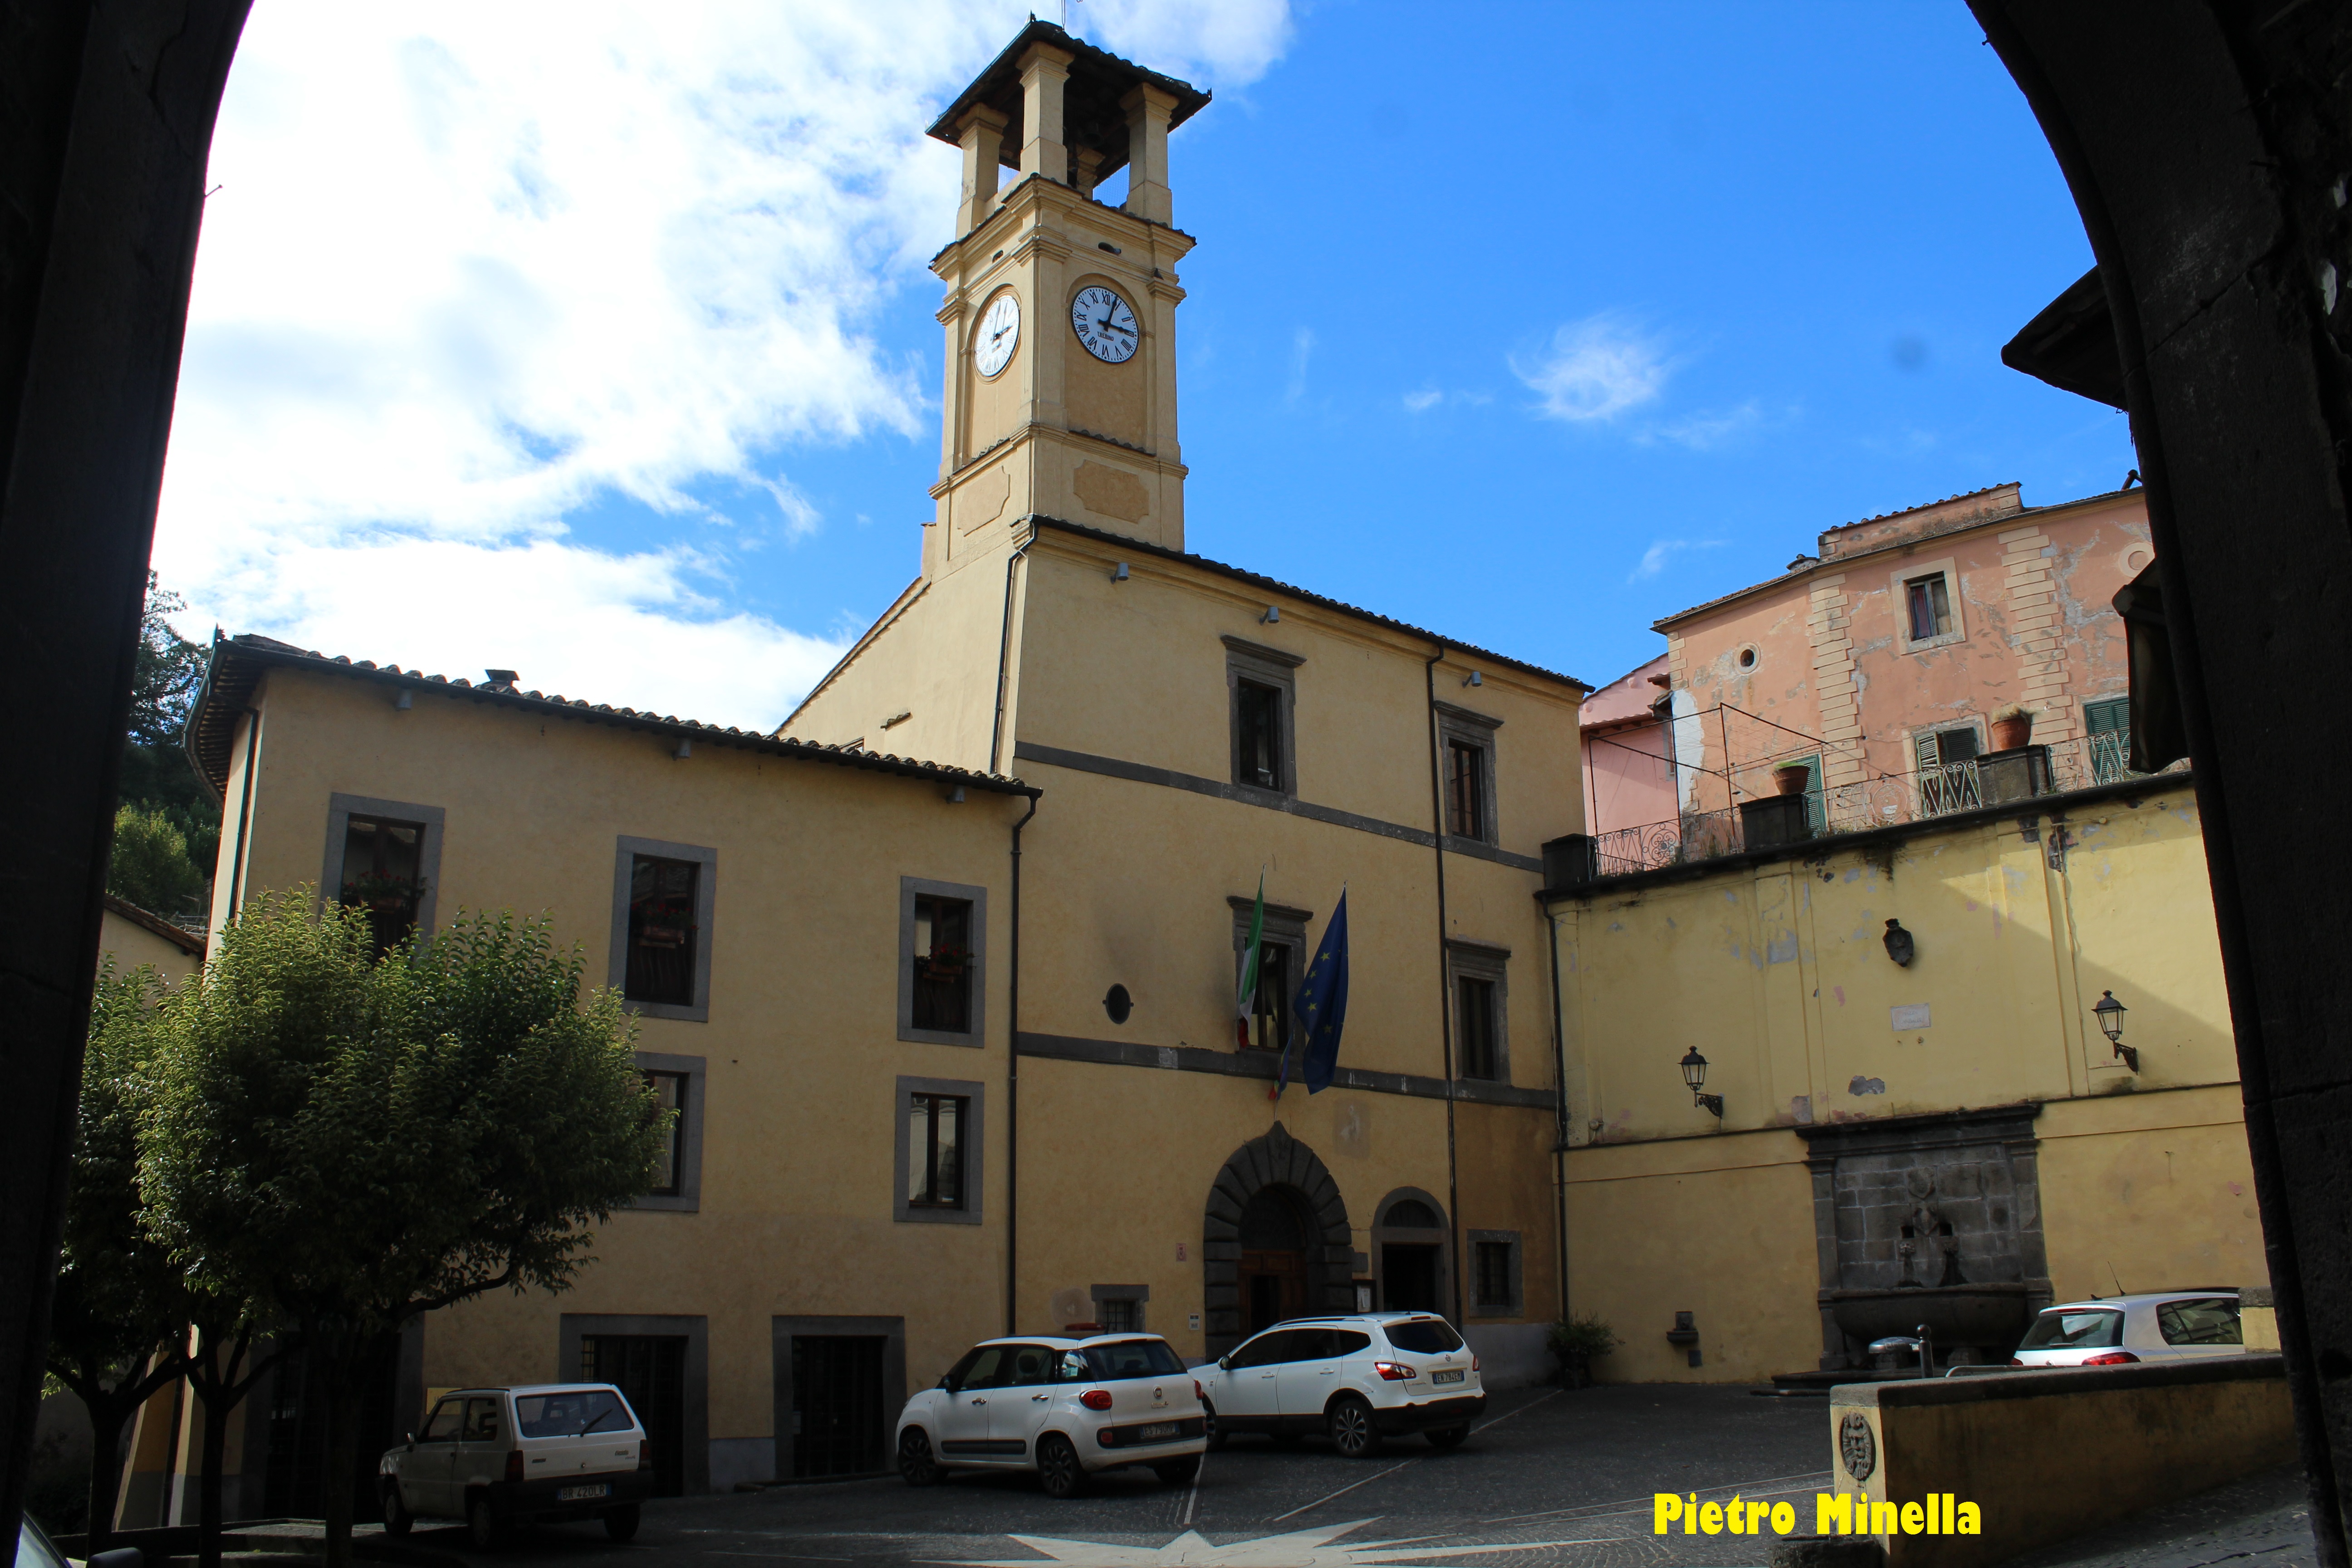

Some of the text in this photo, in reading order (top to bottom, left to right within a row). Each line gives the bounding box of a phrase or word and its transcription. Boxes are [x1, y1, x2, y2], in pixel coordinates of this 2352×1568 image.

[1437, 1372, 1461, 1382] EN 784EM
[1144, 1426, 1153, 1435] ES
[562, 1485, 605, 1499] BR 420LR
